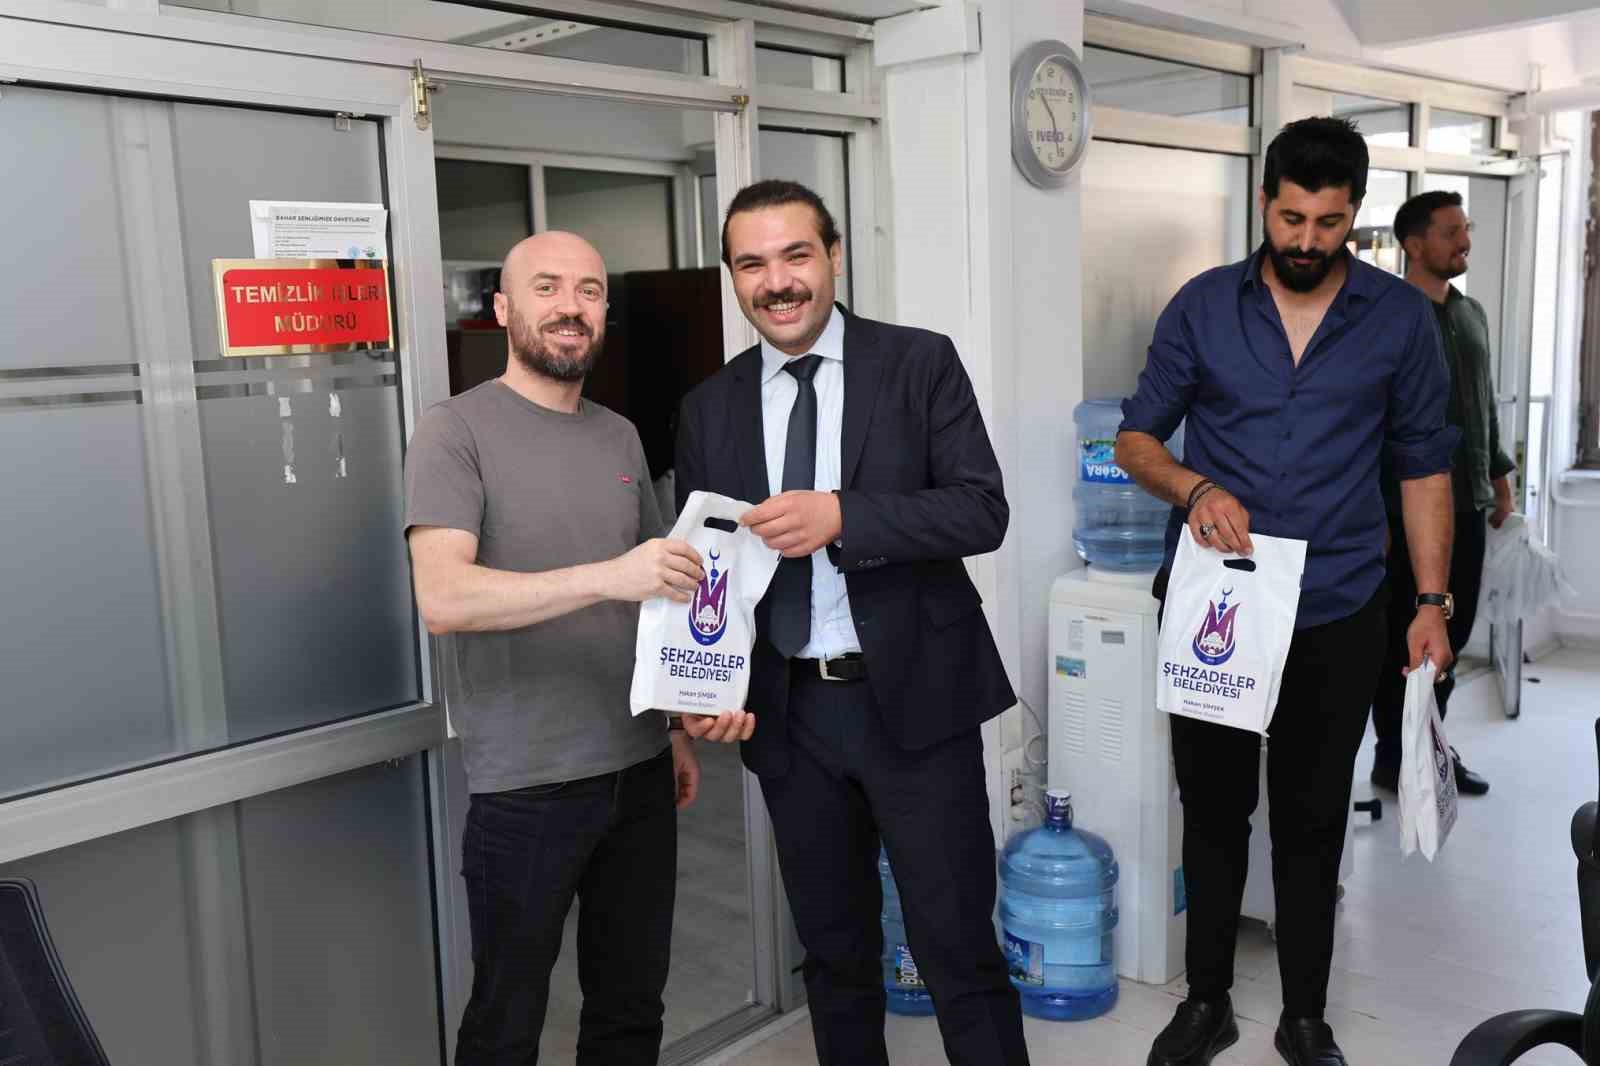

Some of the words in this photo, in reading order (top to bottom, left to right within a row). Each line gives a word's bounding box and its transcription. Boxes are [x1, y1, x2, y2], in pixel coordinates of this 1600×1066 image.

[274, 311, 357, 334] MÜDRÜ
[660, 647, 745, 671] ŞEHZADELER
[670, 664, 731, 682] BELEDİYESİ
[1163, 661, 1256, 690] ŞEHZADELER
[1173, 677, 1241, 700] BELEDİYESİ
